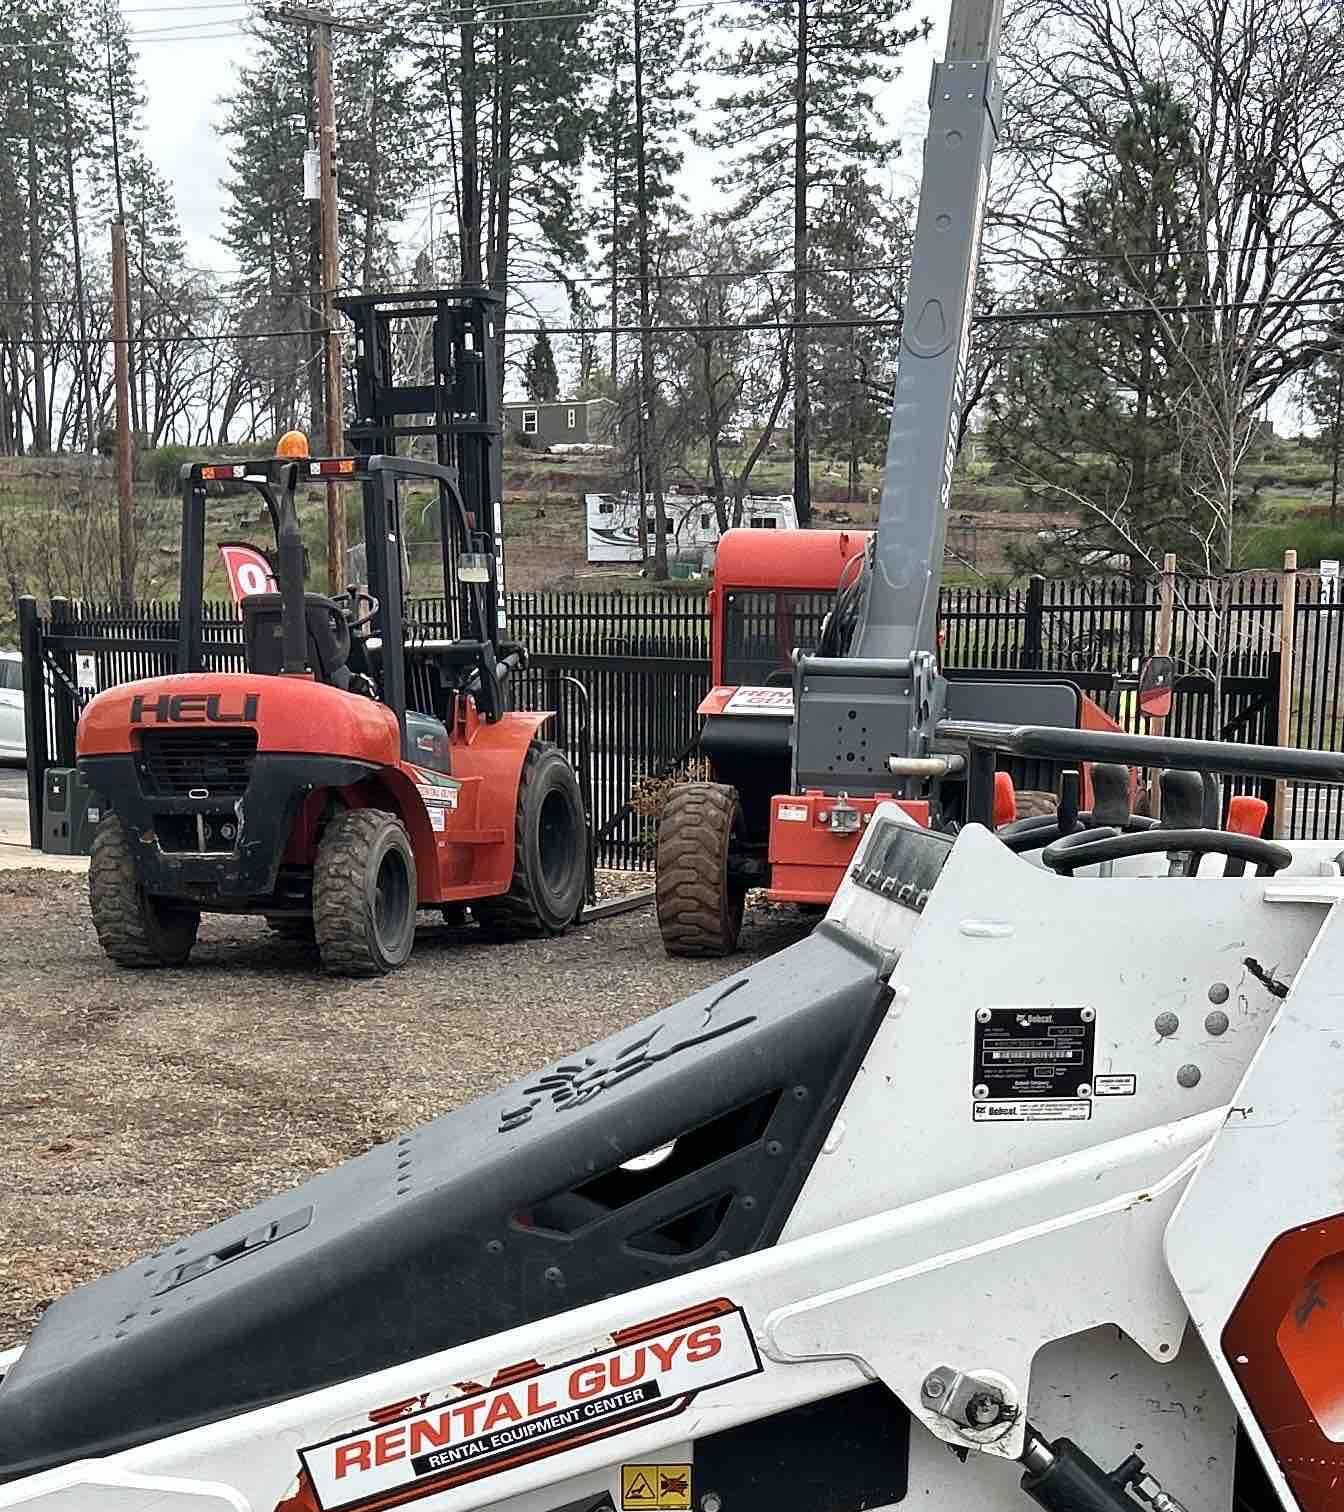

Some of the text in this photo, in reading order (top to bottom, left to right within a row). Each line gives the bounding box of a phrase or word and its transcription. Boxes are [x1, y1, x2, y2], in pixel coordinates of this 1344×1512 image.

[130, 693, 260, 723] HELI
[988, 1106, 1017, 1116] Bobcat
[334, 1324, 723, 1480] RENTAL GUYS
[429, 1387, 645, 1468] RENTAL EQUIPMENT CENTER
